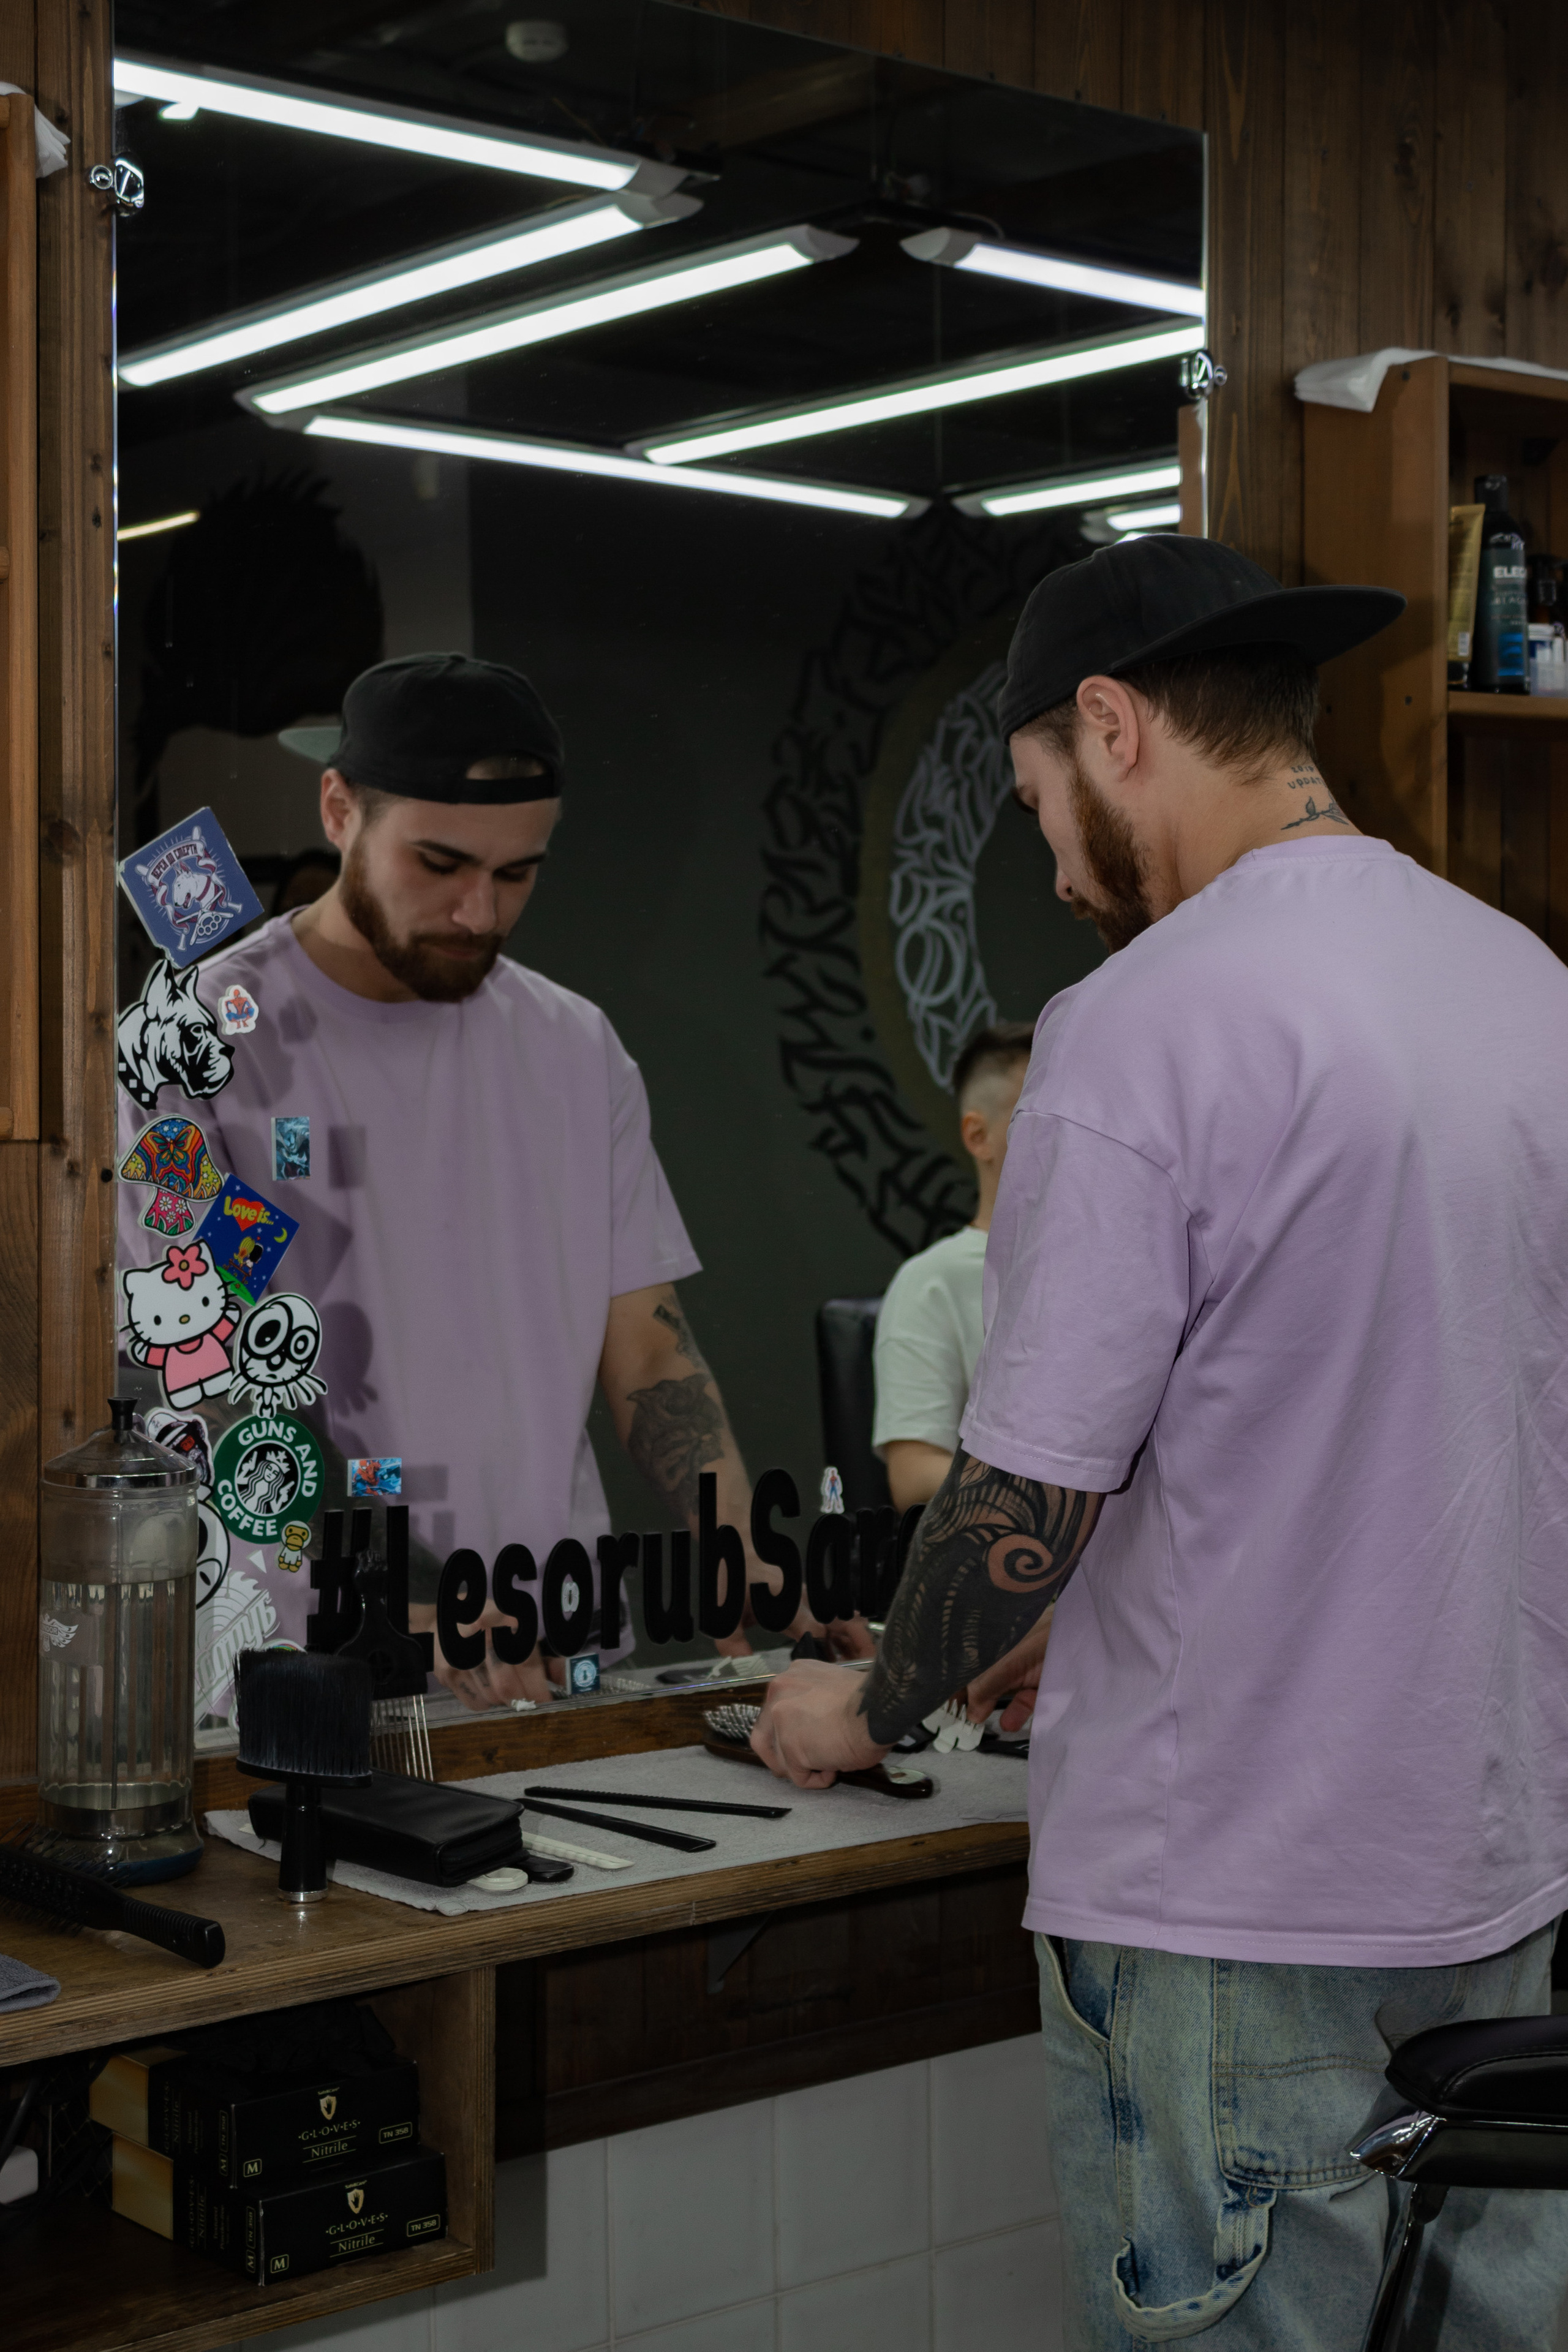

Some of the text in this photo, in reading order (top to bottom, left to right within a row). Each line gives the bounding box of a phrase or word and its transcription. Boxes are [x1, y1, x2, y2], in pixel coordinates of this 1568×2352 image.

[223, 1196, 257, 1221] Love
[217, 1420, 318, 1537] GUNS AND COFFEE
[307, 1468, 926, 1676] #LesorubSar
[383, 2131, 394, 2139] TN
[311, 2141, 349, 2158] Nitrile
[221, 2158, 227, 2171] M
[247, 2162, 258, 2174] M
[338, 2235, 375, 2252] Nitrile
[247, 2255, 254, 2269] M
[274, 2258, 285, 2270] M
